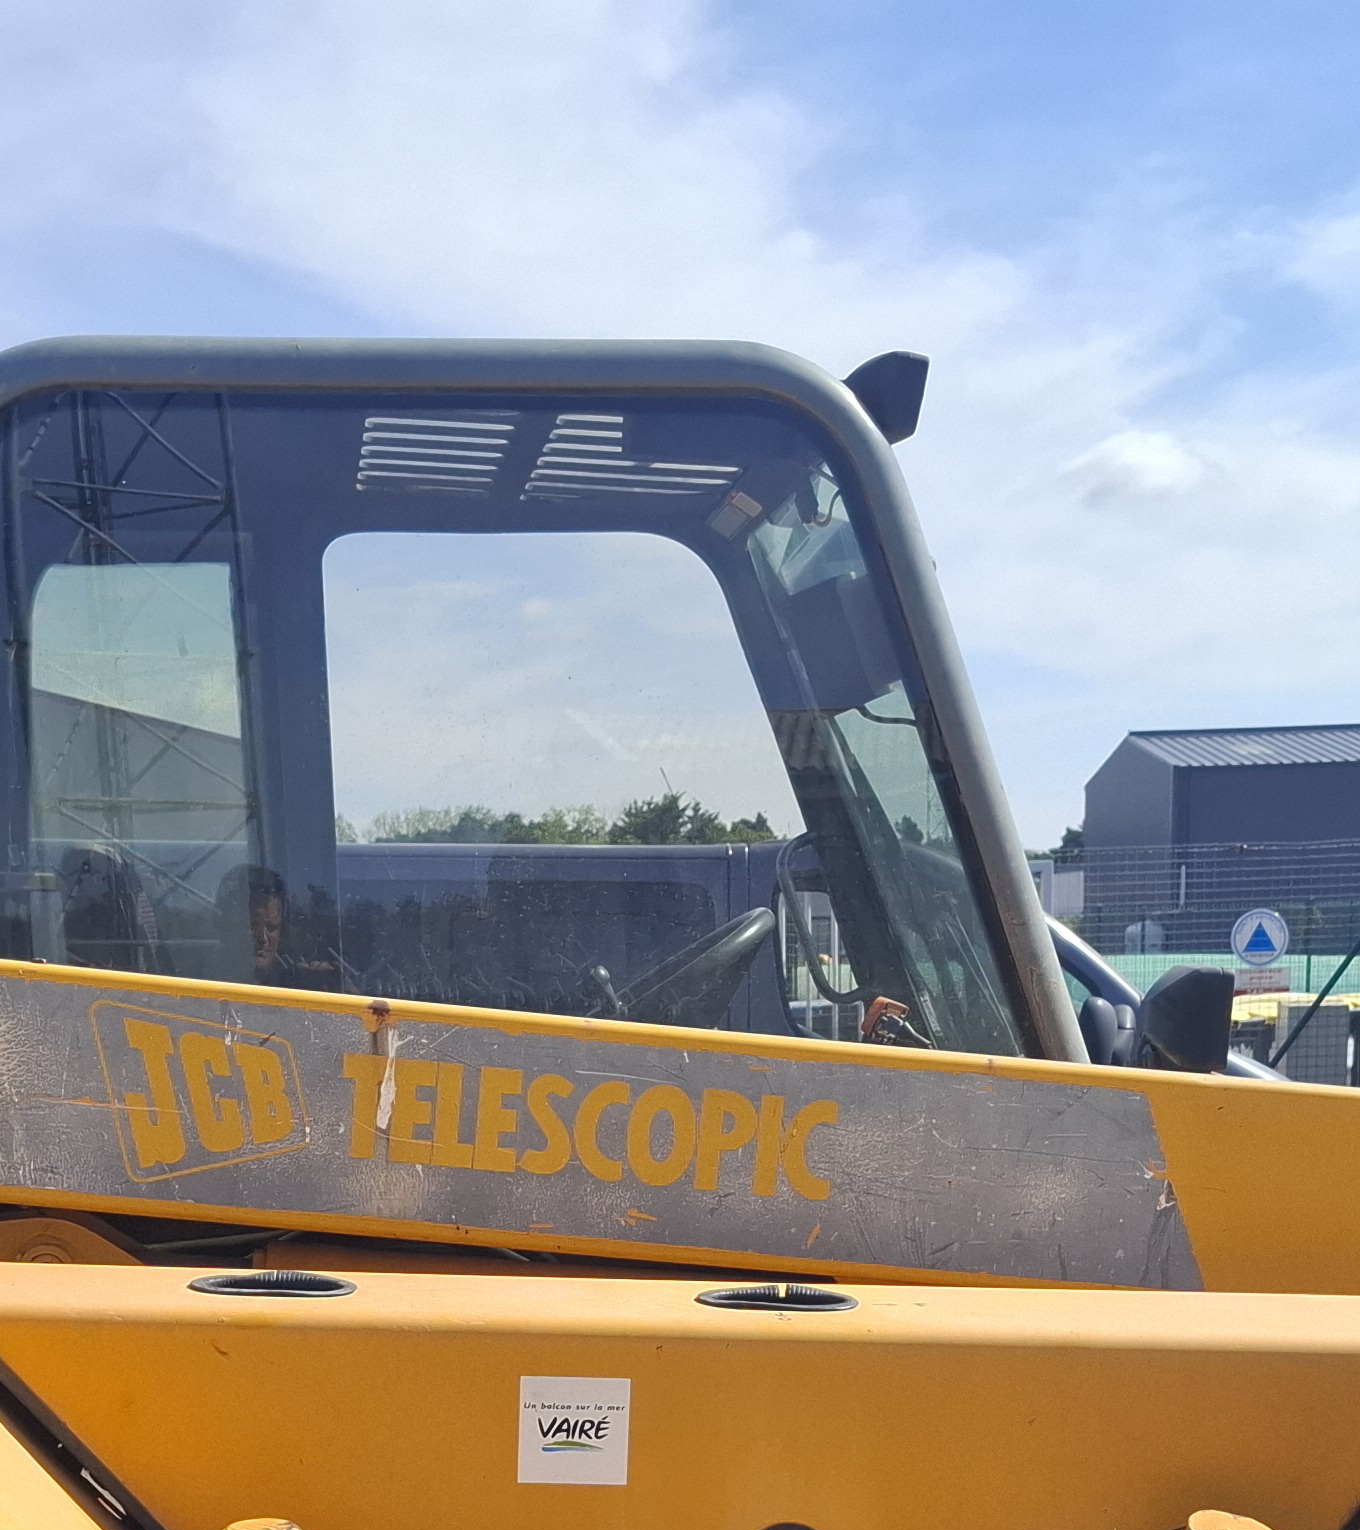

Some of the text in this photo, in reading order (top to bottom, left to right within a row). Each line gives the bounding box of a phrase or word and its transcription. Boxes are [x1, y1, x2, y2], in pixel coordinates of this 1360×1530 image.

[124, 1018, 840, 1200] JCB TELESCOPIC
[540, 1402, 572, 1411] balcon
[606, 1404, 626, 1412] mer
[537, 1415, 611, 1440] VAIRÉ
